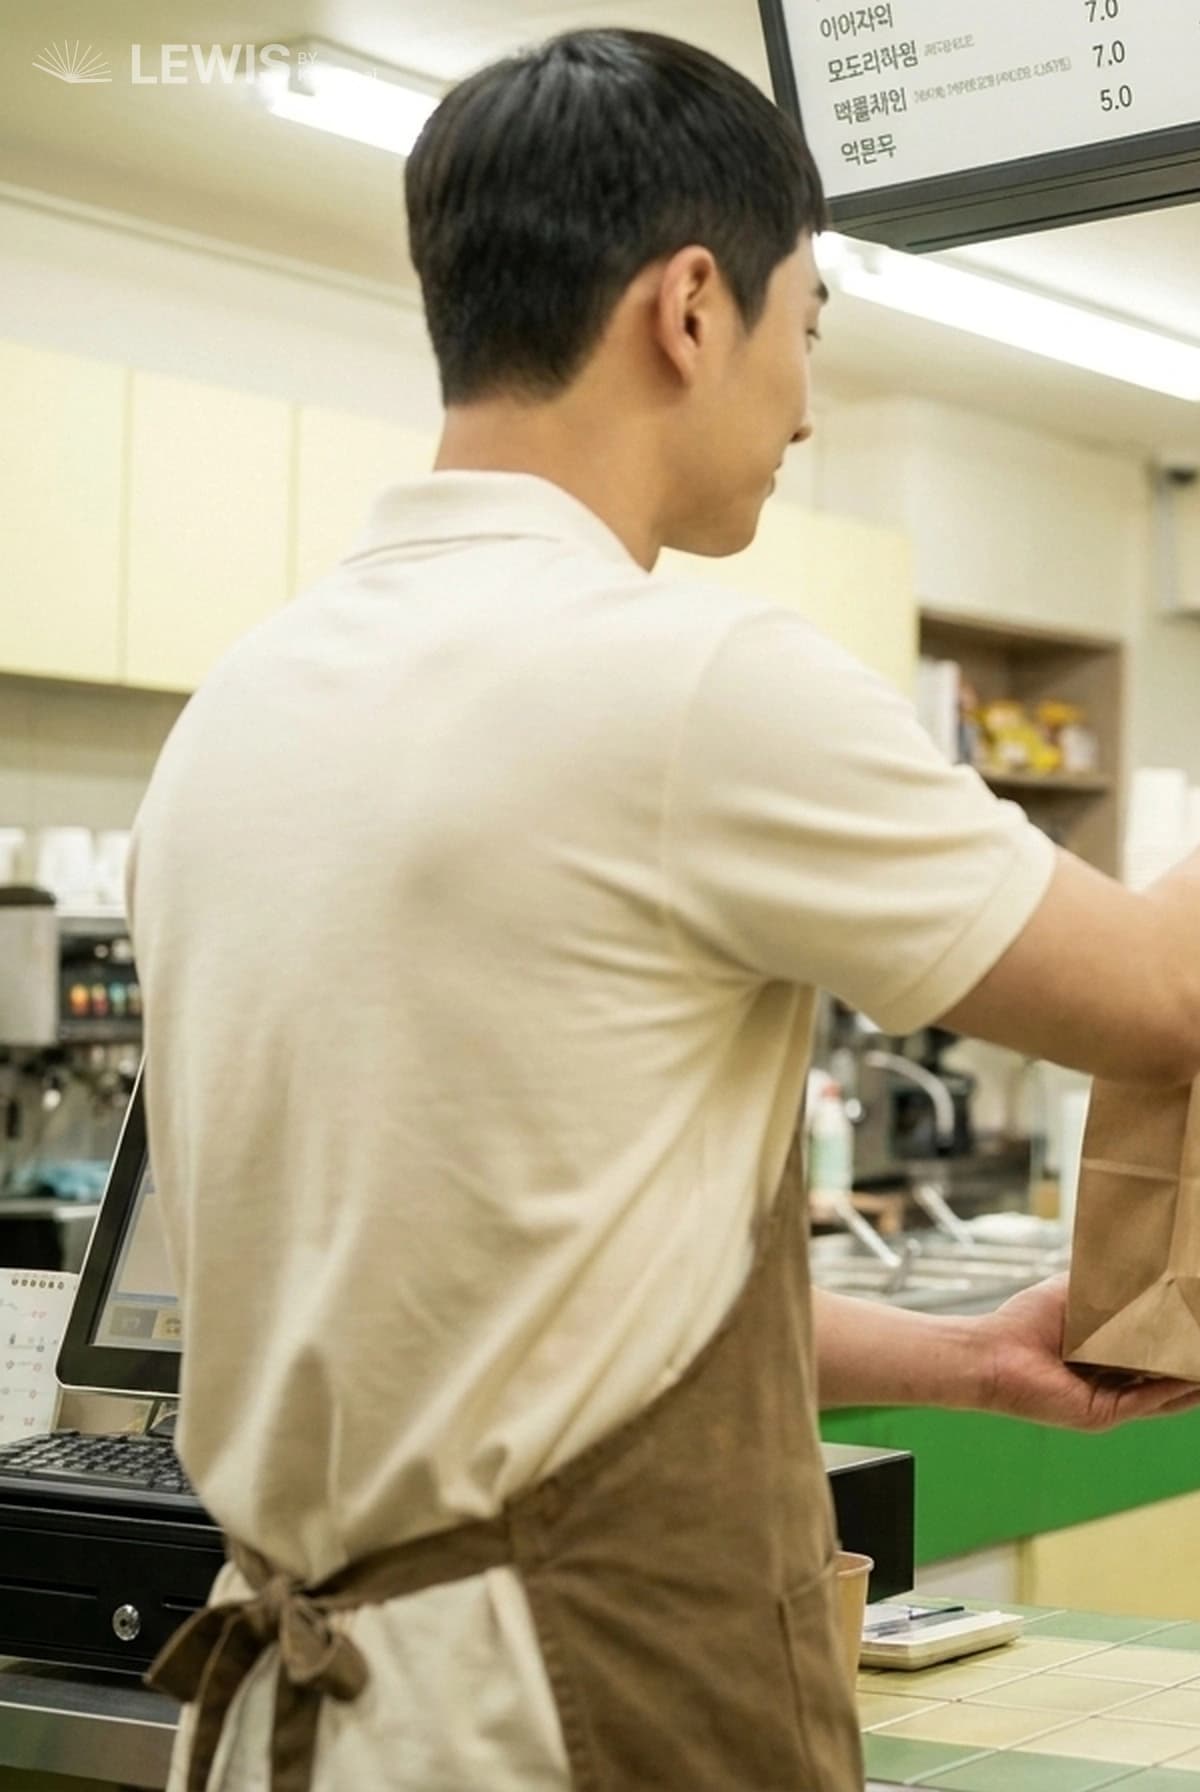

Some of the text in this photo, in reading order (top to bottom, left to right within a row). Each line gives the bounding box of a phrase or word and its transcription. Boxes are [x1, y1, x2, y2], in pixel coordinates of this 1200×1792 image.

[1084, 0, 1118, 22] 7.0
[1092, 40, 1125, 67] 7.0
[1100, 85, 1132, 111] 5.0
